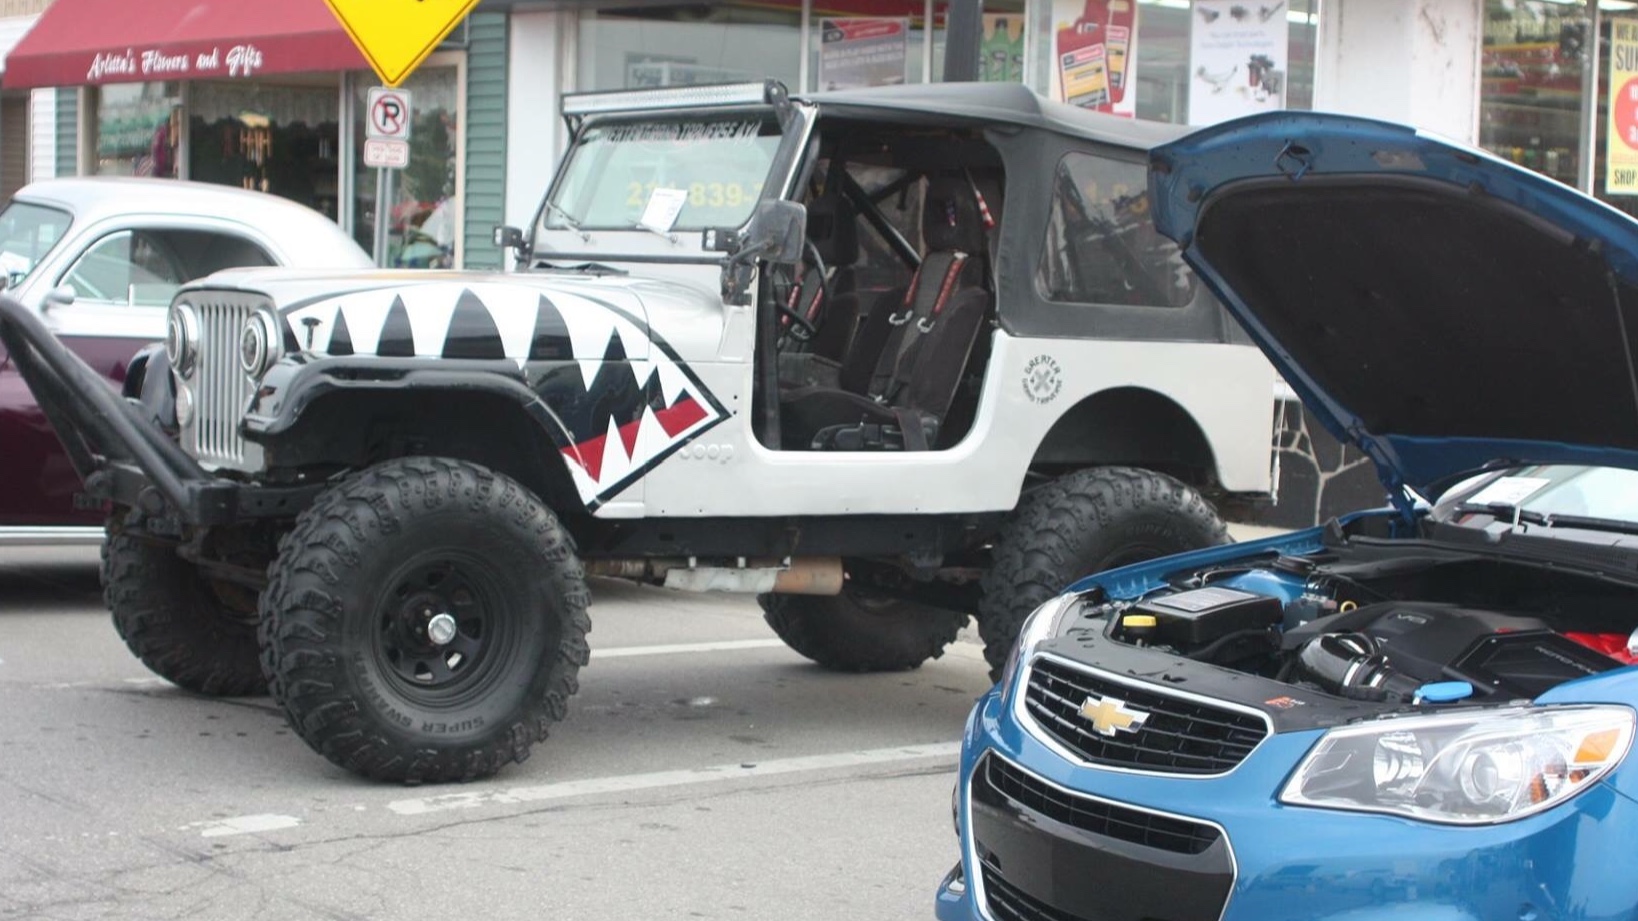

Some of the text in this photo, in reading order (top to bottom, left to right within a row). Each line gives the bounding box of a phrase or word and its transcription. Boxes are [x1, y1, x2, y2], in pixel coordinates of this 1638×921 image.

[141, 50, 189, 75] Flowers
[196, 47, 219, 69] and
[225, 44, 263, 77] Gifts
[382, 102, 400, 127] P
[1614, 168, 1636, 185] SHOP
[420, 714, 485, 734] SUPER
